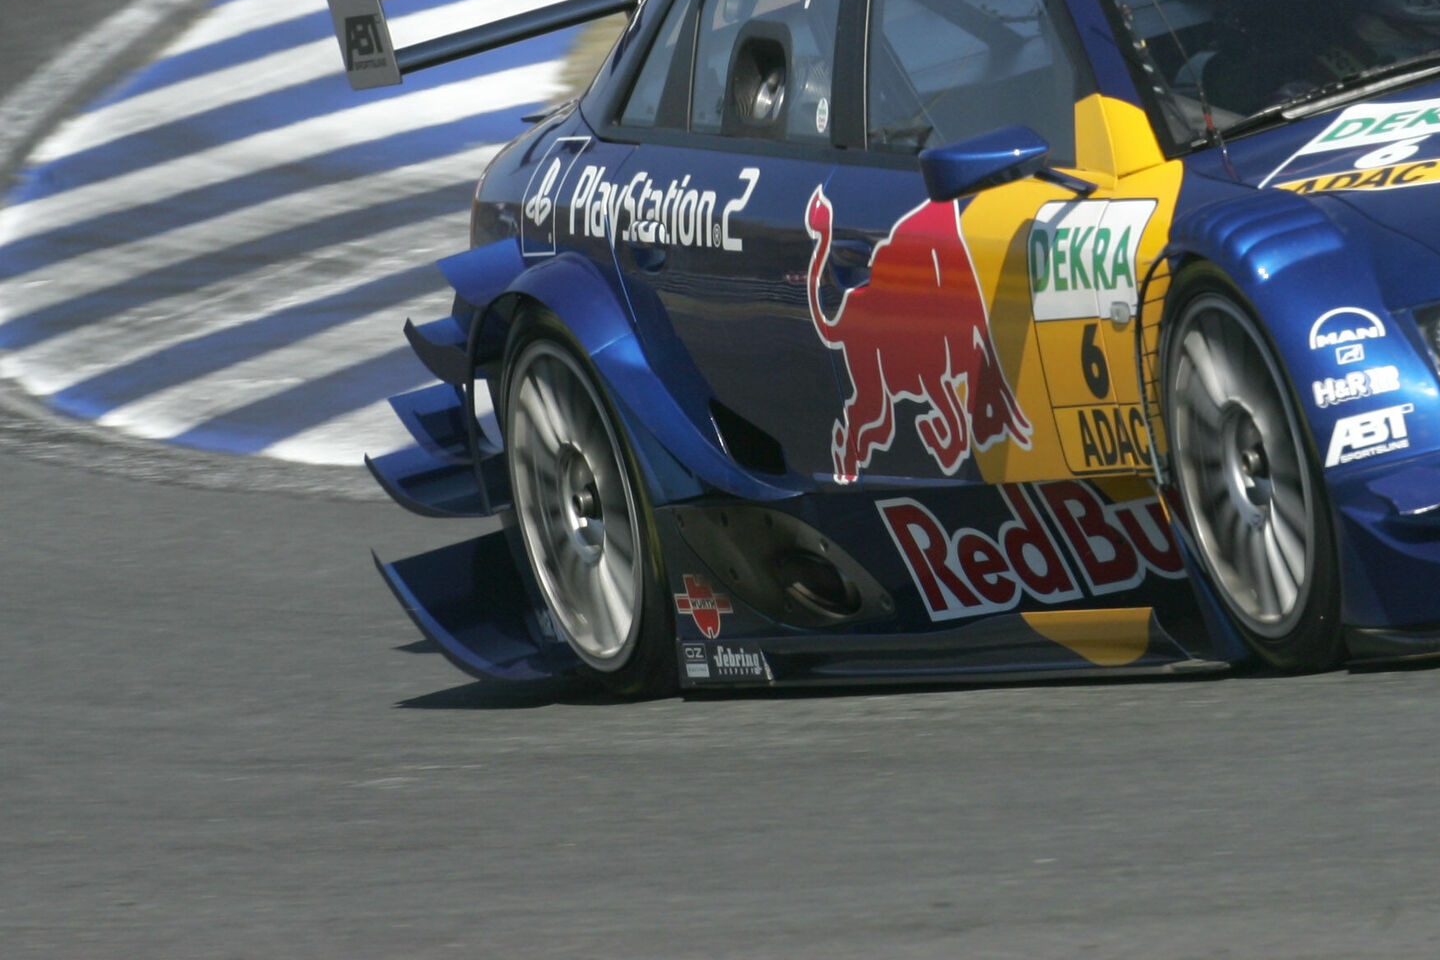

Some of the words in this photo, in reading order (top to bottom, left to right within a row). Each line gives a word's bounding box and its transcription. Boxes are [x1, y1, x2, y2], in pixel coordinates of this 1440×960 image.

[1354, 134, 1433, 170] 6
[1029, 224, 1135, 294] DEKRA
[1081, 323, 1110, 400] 6
[1316, 326, 1379, 348] MAN
[1312, 370, 1371, 409] H&R
[1077, 406, 1153, 468] ADAC
[1324, 403, 1415, 468] ABT
[874, 482, 1085, 622] Red
[1032, 482, 1202, 597] Bu
